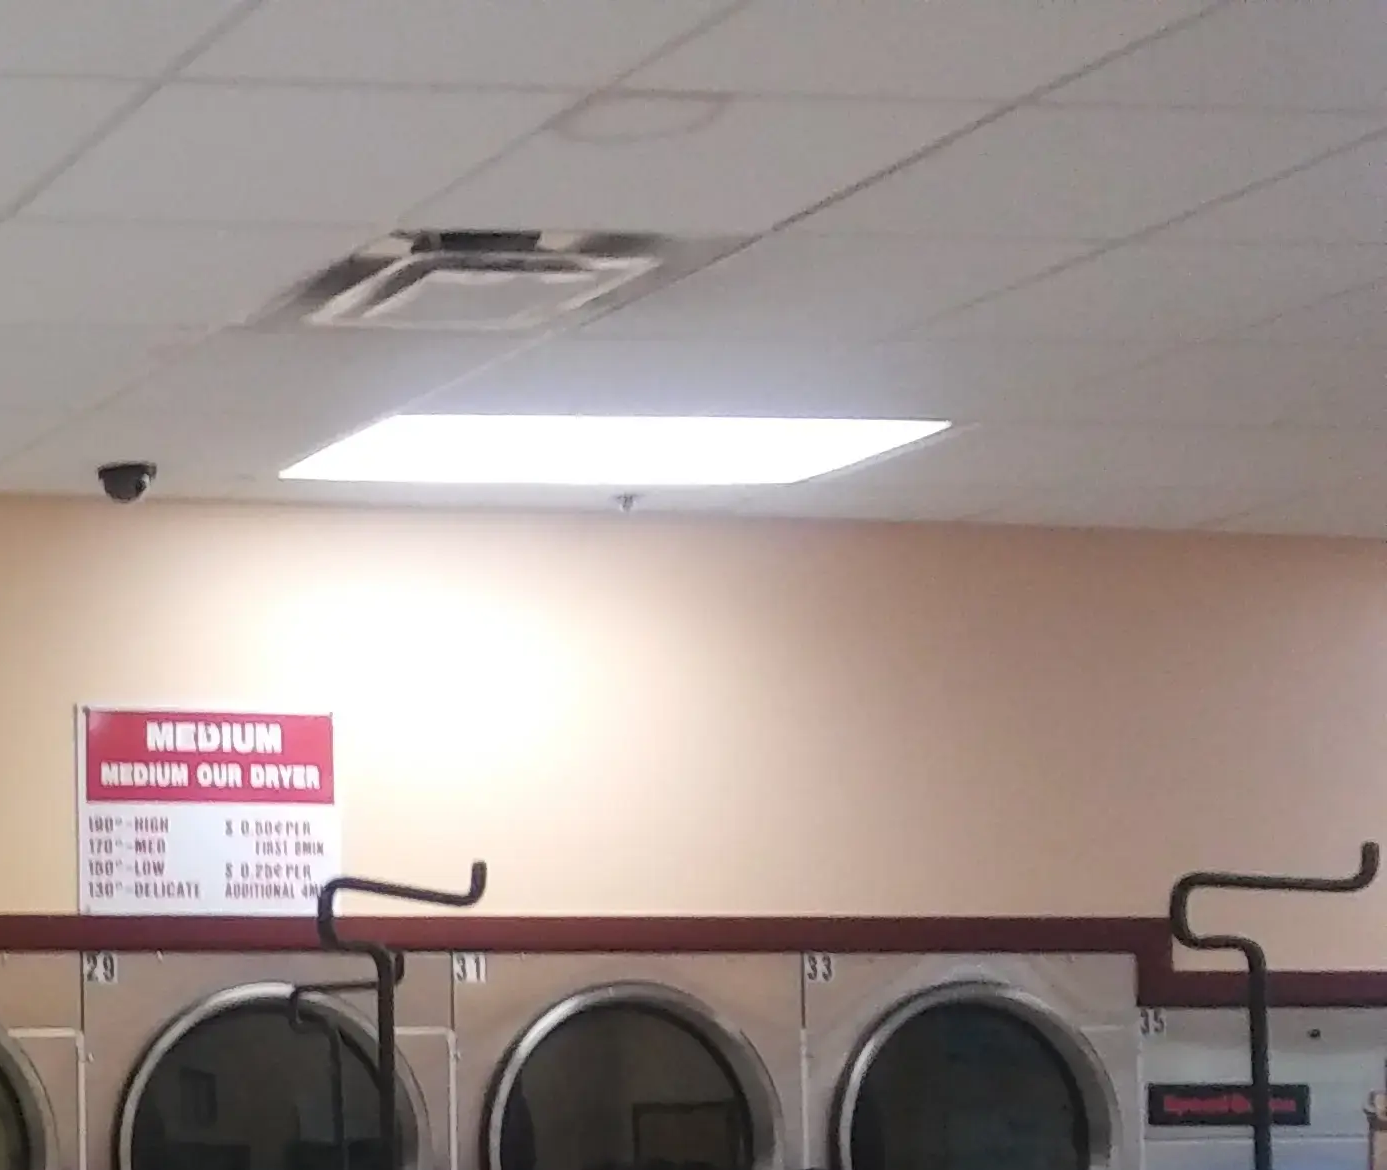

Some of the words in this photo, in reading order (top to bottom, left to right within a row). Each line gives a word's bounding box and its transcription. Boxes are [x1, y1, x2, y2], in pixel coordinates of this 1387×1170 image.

[146, 720, 283, 754] MEDIUM
[100, 761, 189, 787] MEDIUM
[196, 763, 242, 788] OUR
[249, 764, 320, 790] DRYER
[225, 883, 295, 899] ADDITIONAL
[85, 950, 116, 982] 29
[455, 950, 484, 982] 31
[806, 953, 833, 982] 33
[1139, 1007, 1166, 1036] 35
